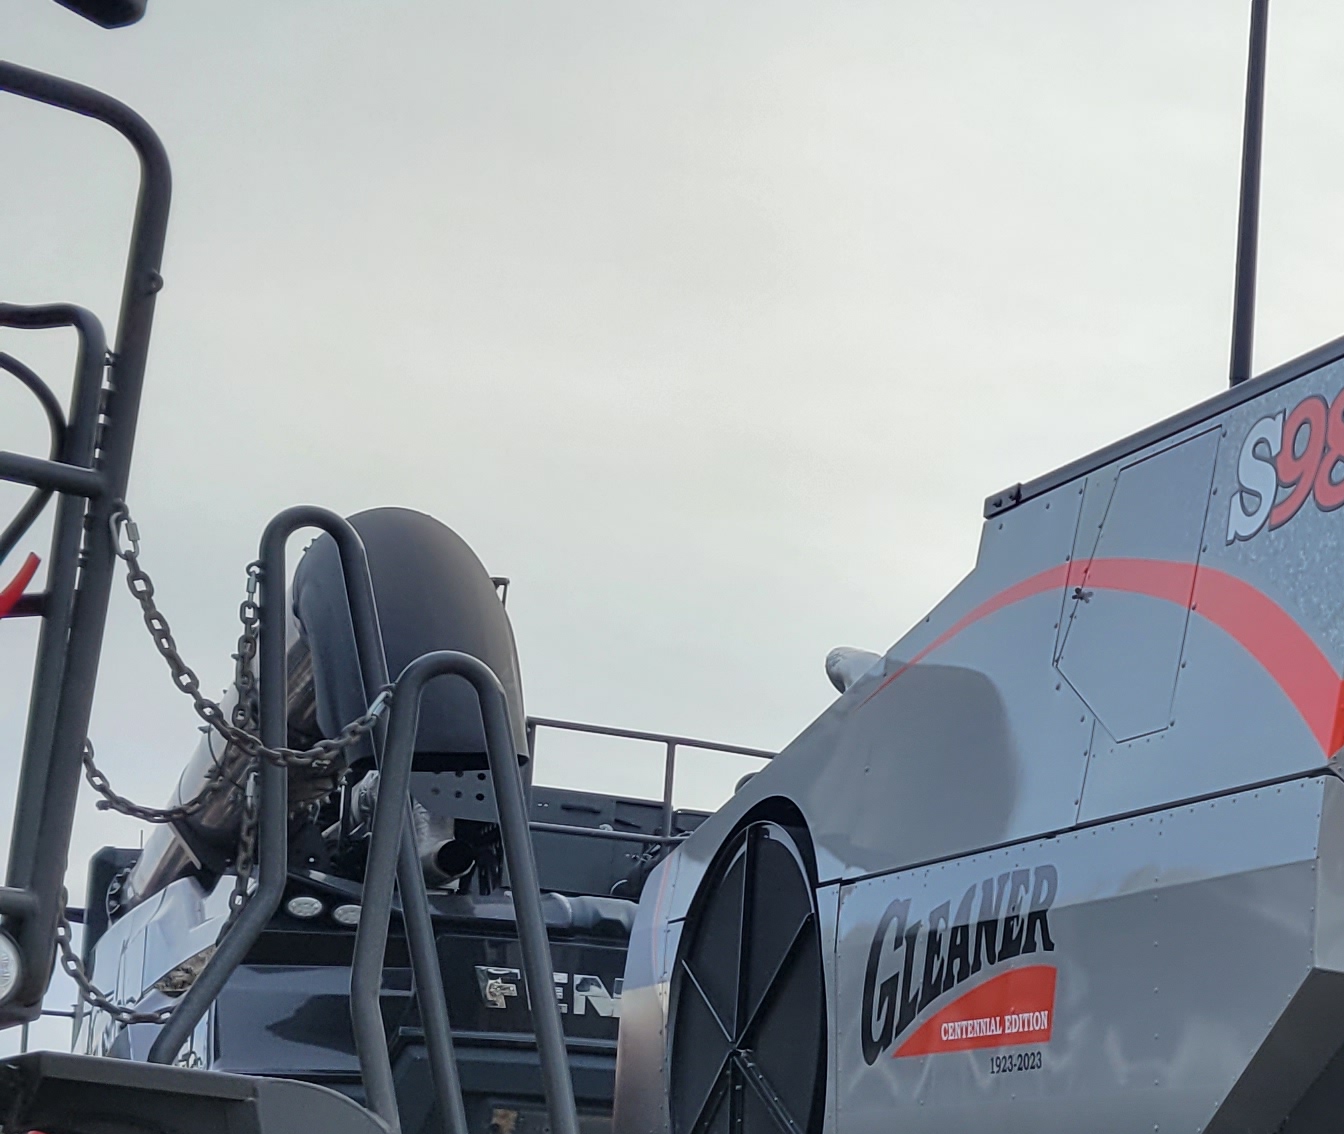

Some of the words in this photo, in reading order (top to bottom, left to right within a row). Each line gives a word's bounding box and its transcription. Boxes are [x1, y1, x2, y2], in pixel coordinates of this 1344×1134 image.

[860, 864, 1058, 1067] GLEANER
[940, 1018, 1002, 1041] CENTENNIAL
[1004, 1010, 1048, 1034] EDITION
[990, 1051, 1042, 1074] 1923-2023
